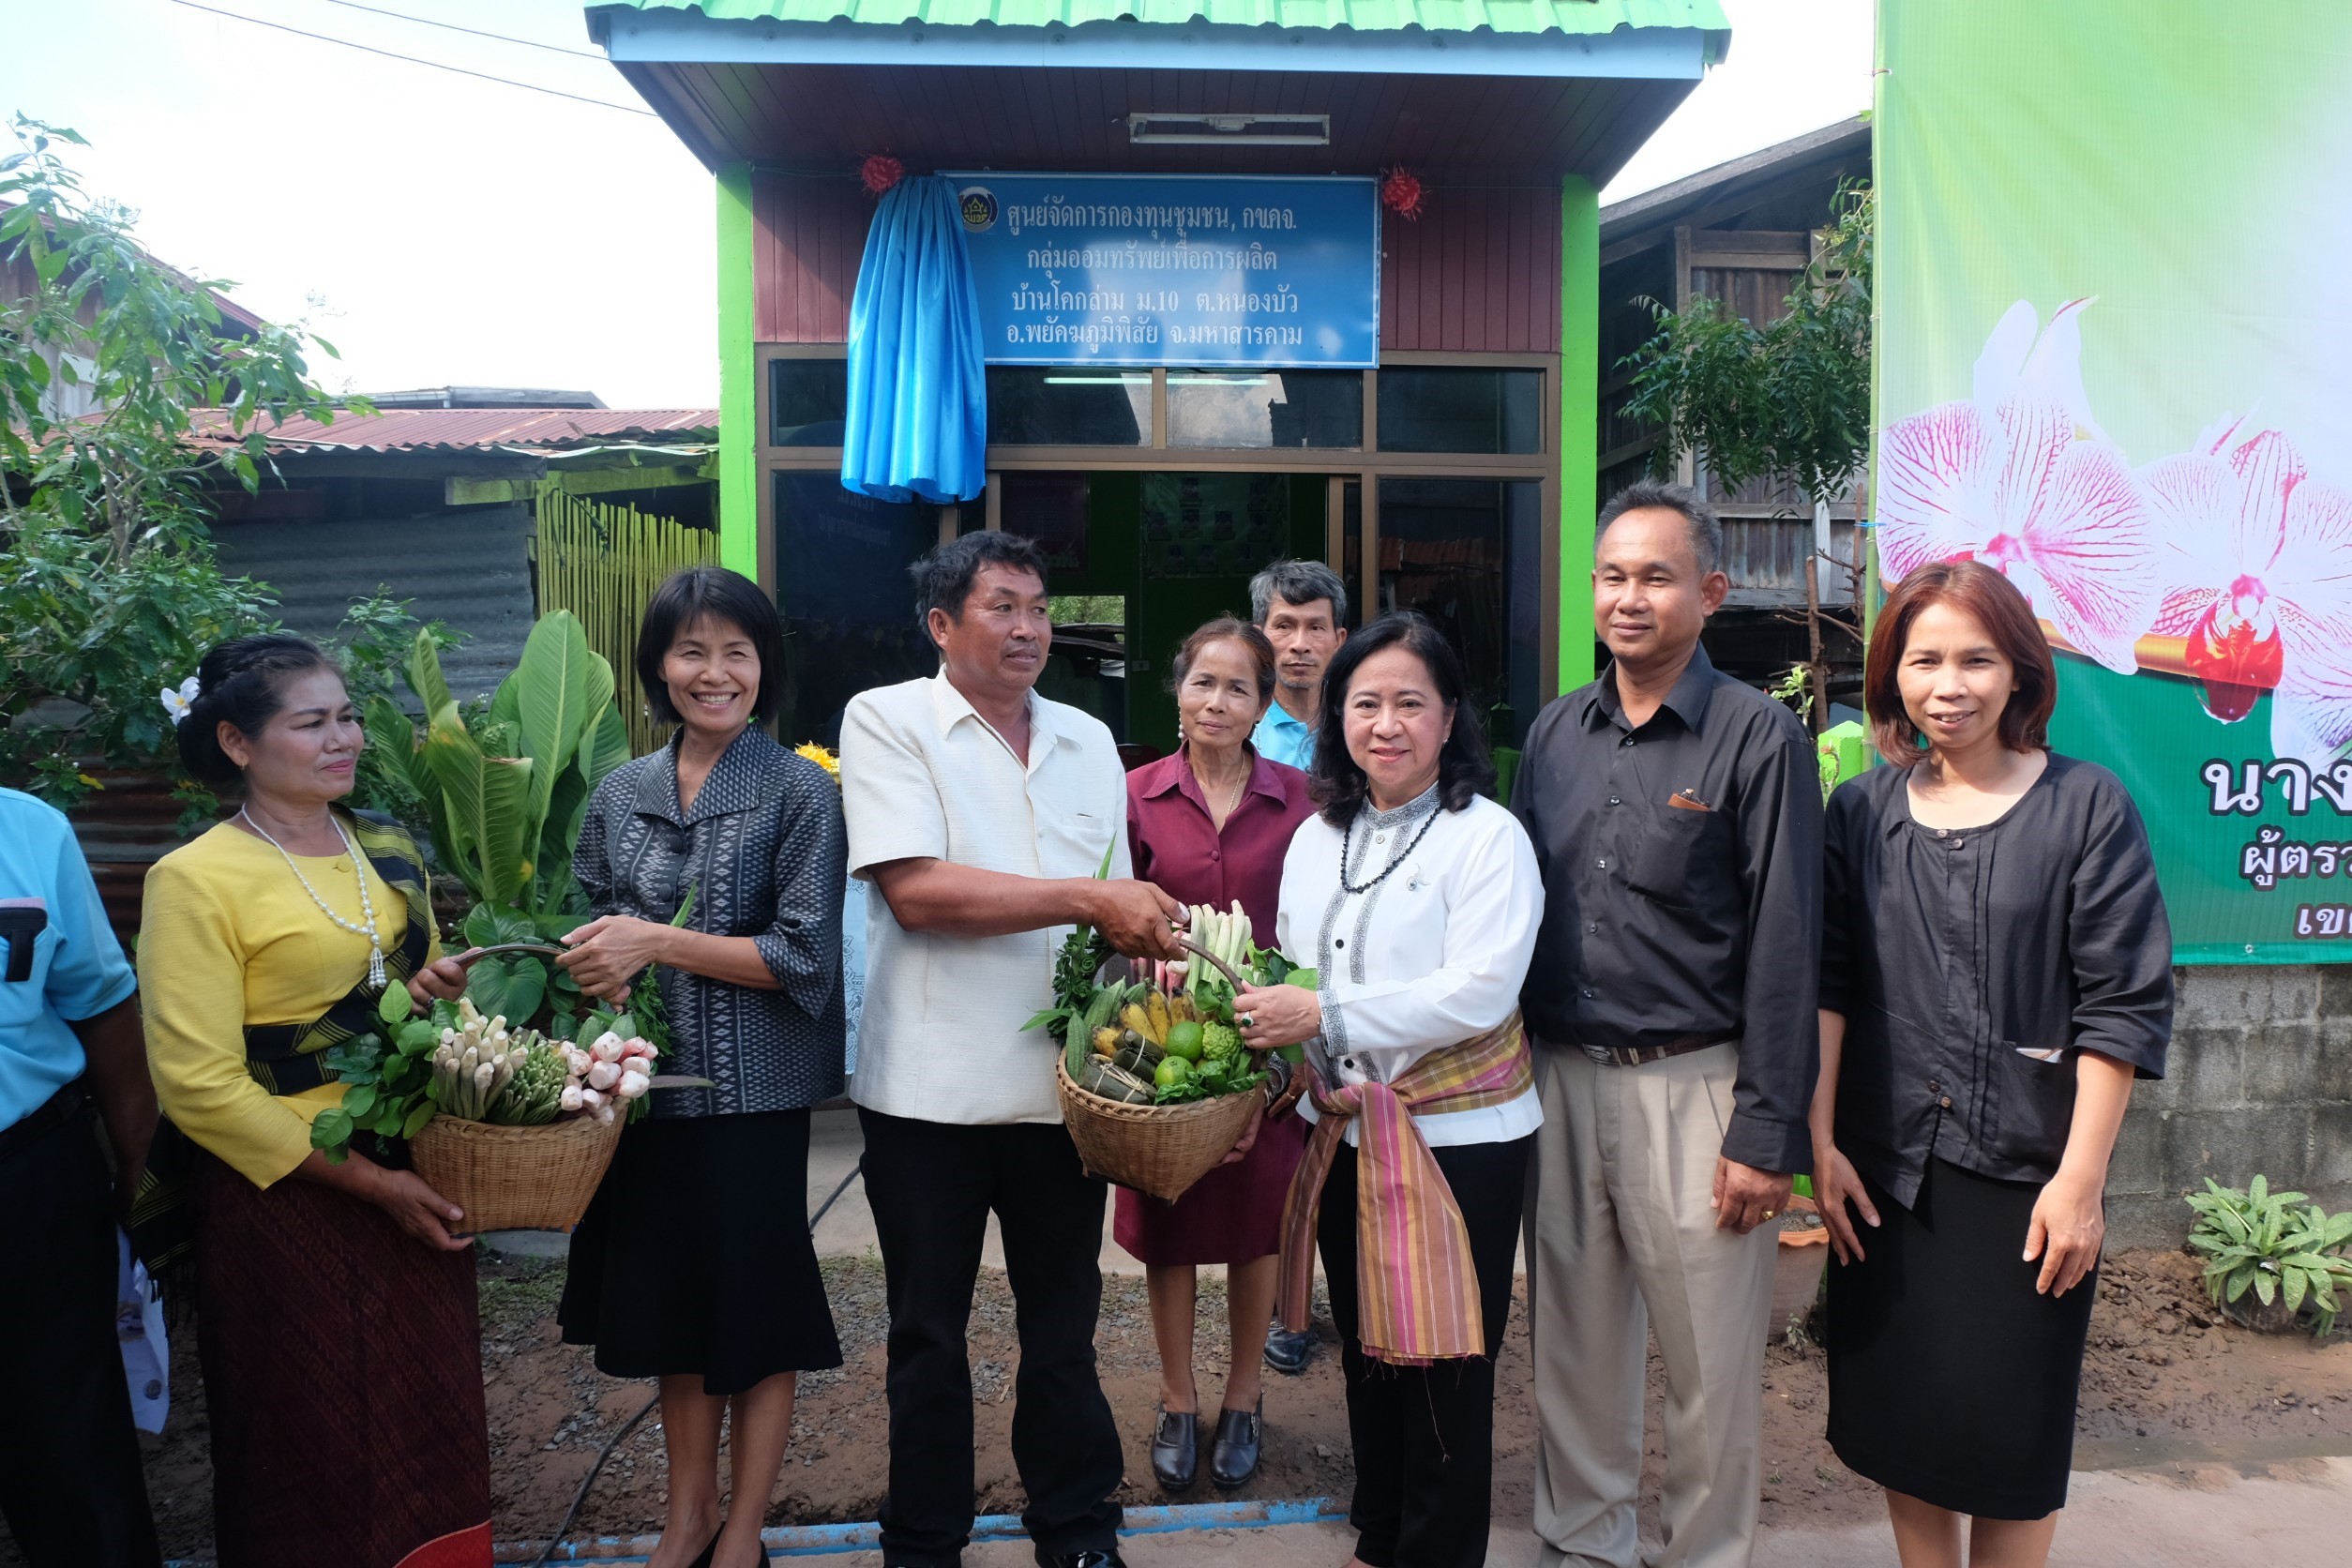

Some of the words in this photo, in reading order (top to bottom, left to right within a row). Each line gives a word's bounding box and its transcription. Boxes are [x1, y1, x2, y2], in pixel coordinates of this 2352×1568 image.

[1007, 194, 1236, 240] ศูนย์จัดการกองทุนชุมชน,
[1027, 232, 1277, 279] กลุ่มออมทรัพย์เพื่อการผลิต
[1012, 279, 1124, 311] บ้านโคกล่าม
[1137, 290, 1179, 312] ม.10
[1197, 283, 1298, 313] ต.หนองบัว
[1006, 315, 1158, 354] อ.พยัคฆภูมิพิสัย
[1169, 324, 1302, 345] จ.มหาสารคาม
[2297, 907, 2352, 935] เข
